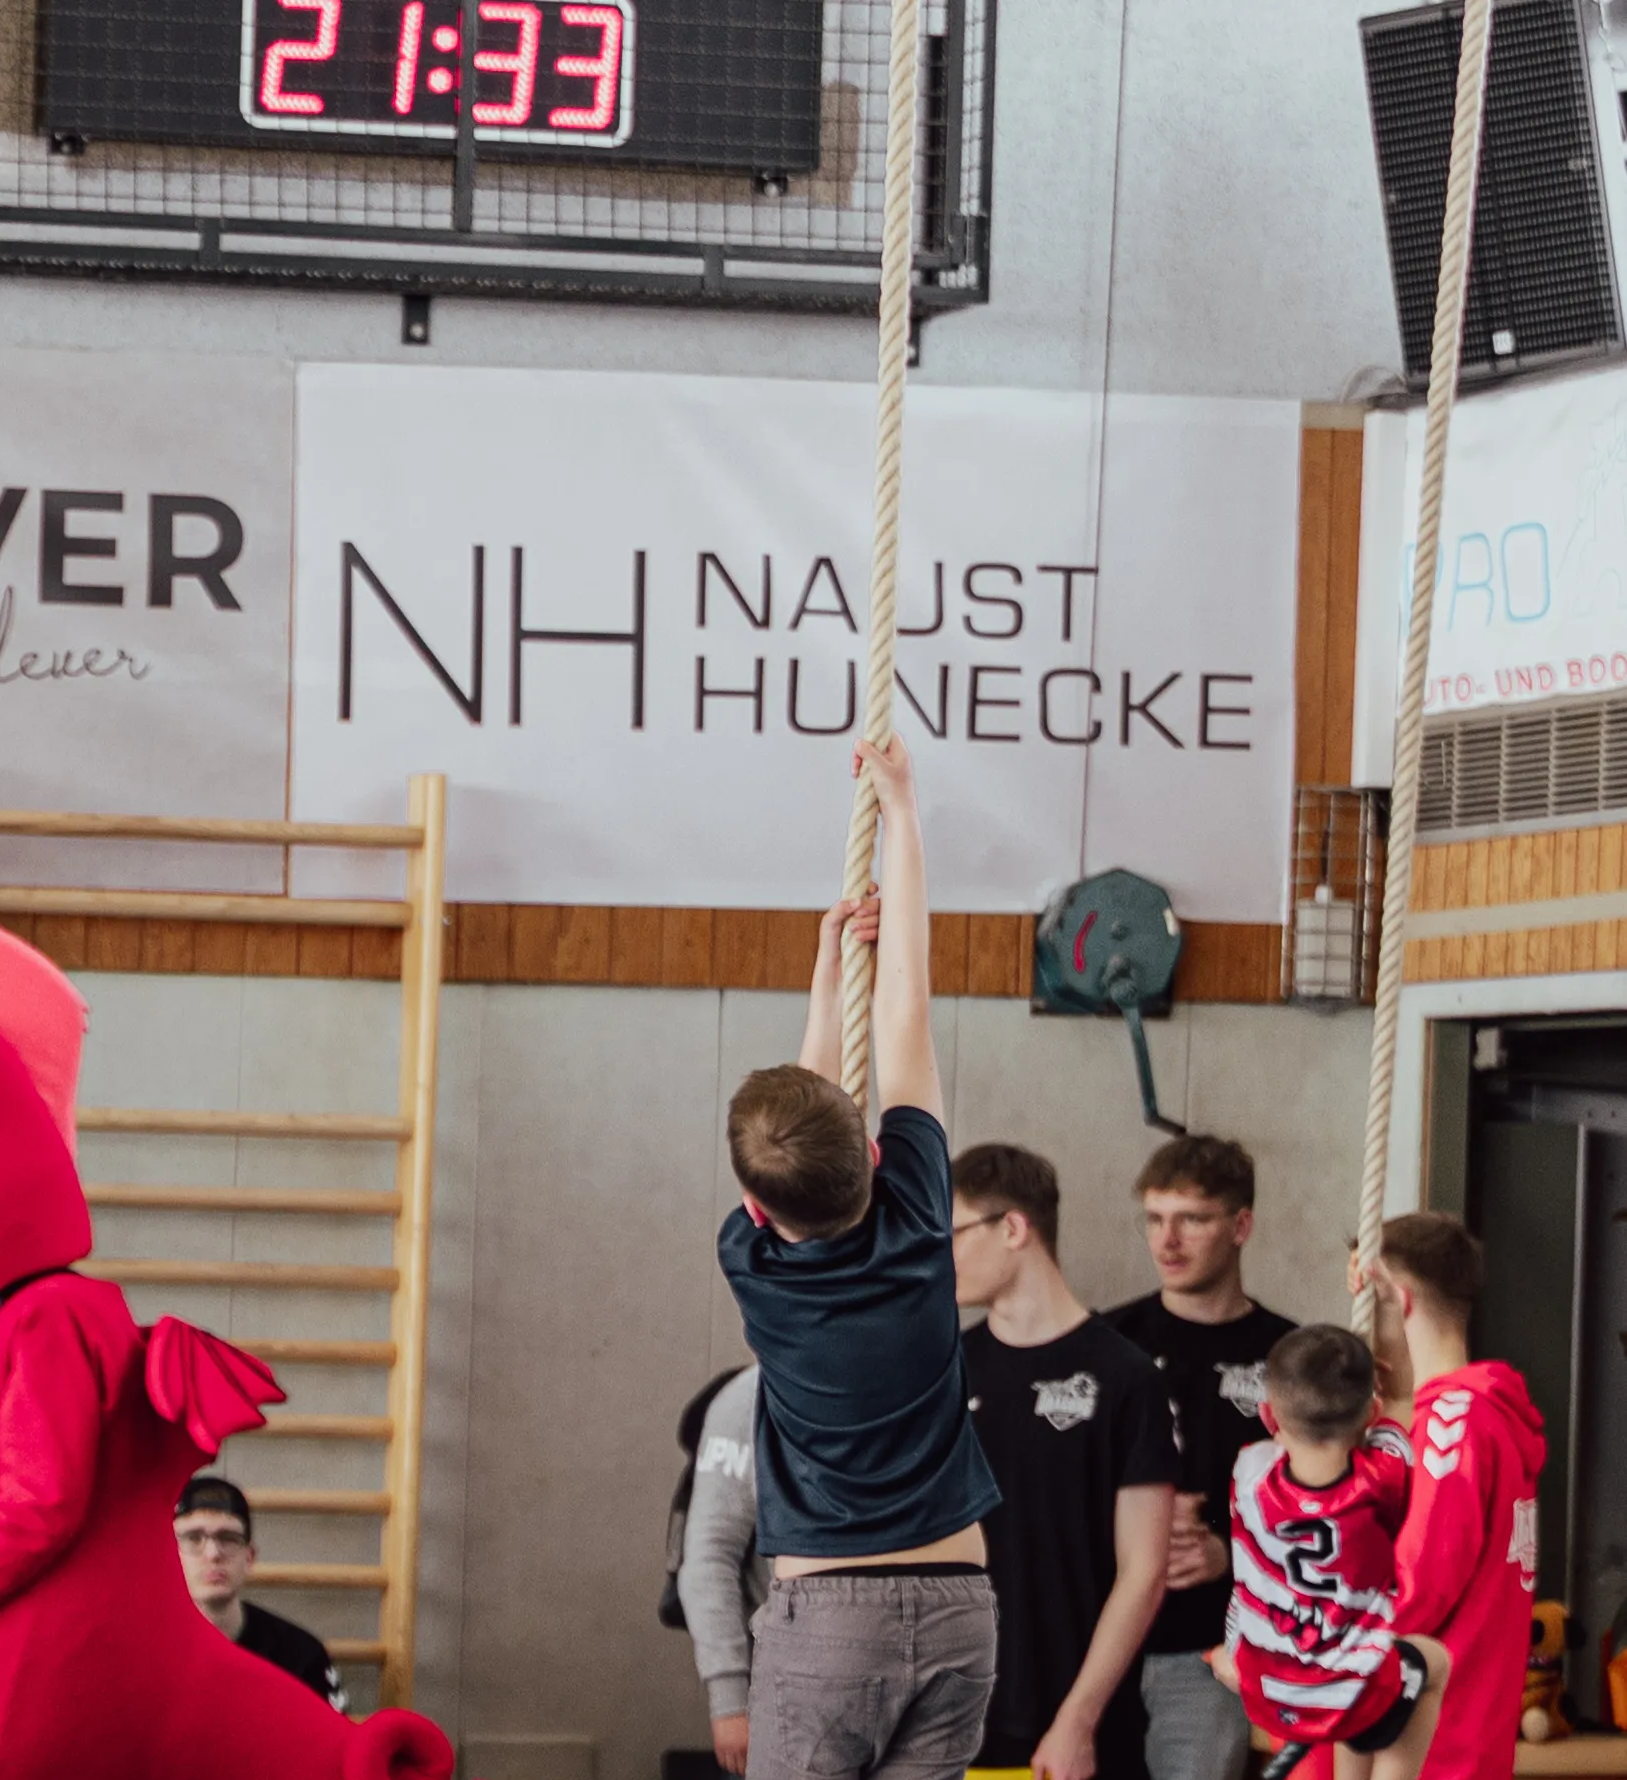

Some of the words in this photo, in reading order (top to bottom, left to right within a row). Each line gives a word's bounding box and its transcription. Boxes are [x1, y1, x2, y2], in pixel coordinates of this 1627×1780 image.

[260, 0, 623, 129] 21:33
[337, 540, 647, 731] NH
[1494, 662, 1556, 697] UND
[695, 655, 1254, 751] HUNECKE
[1275, 1517, 1342, 1595] 2
